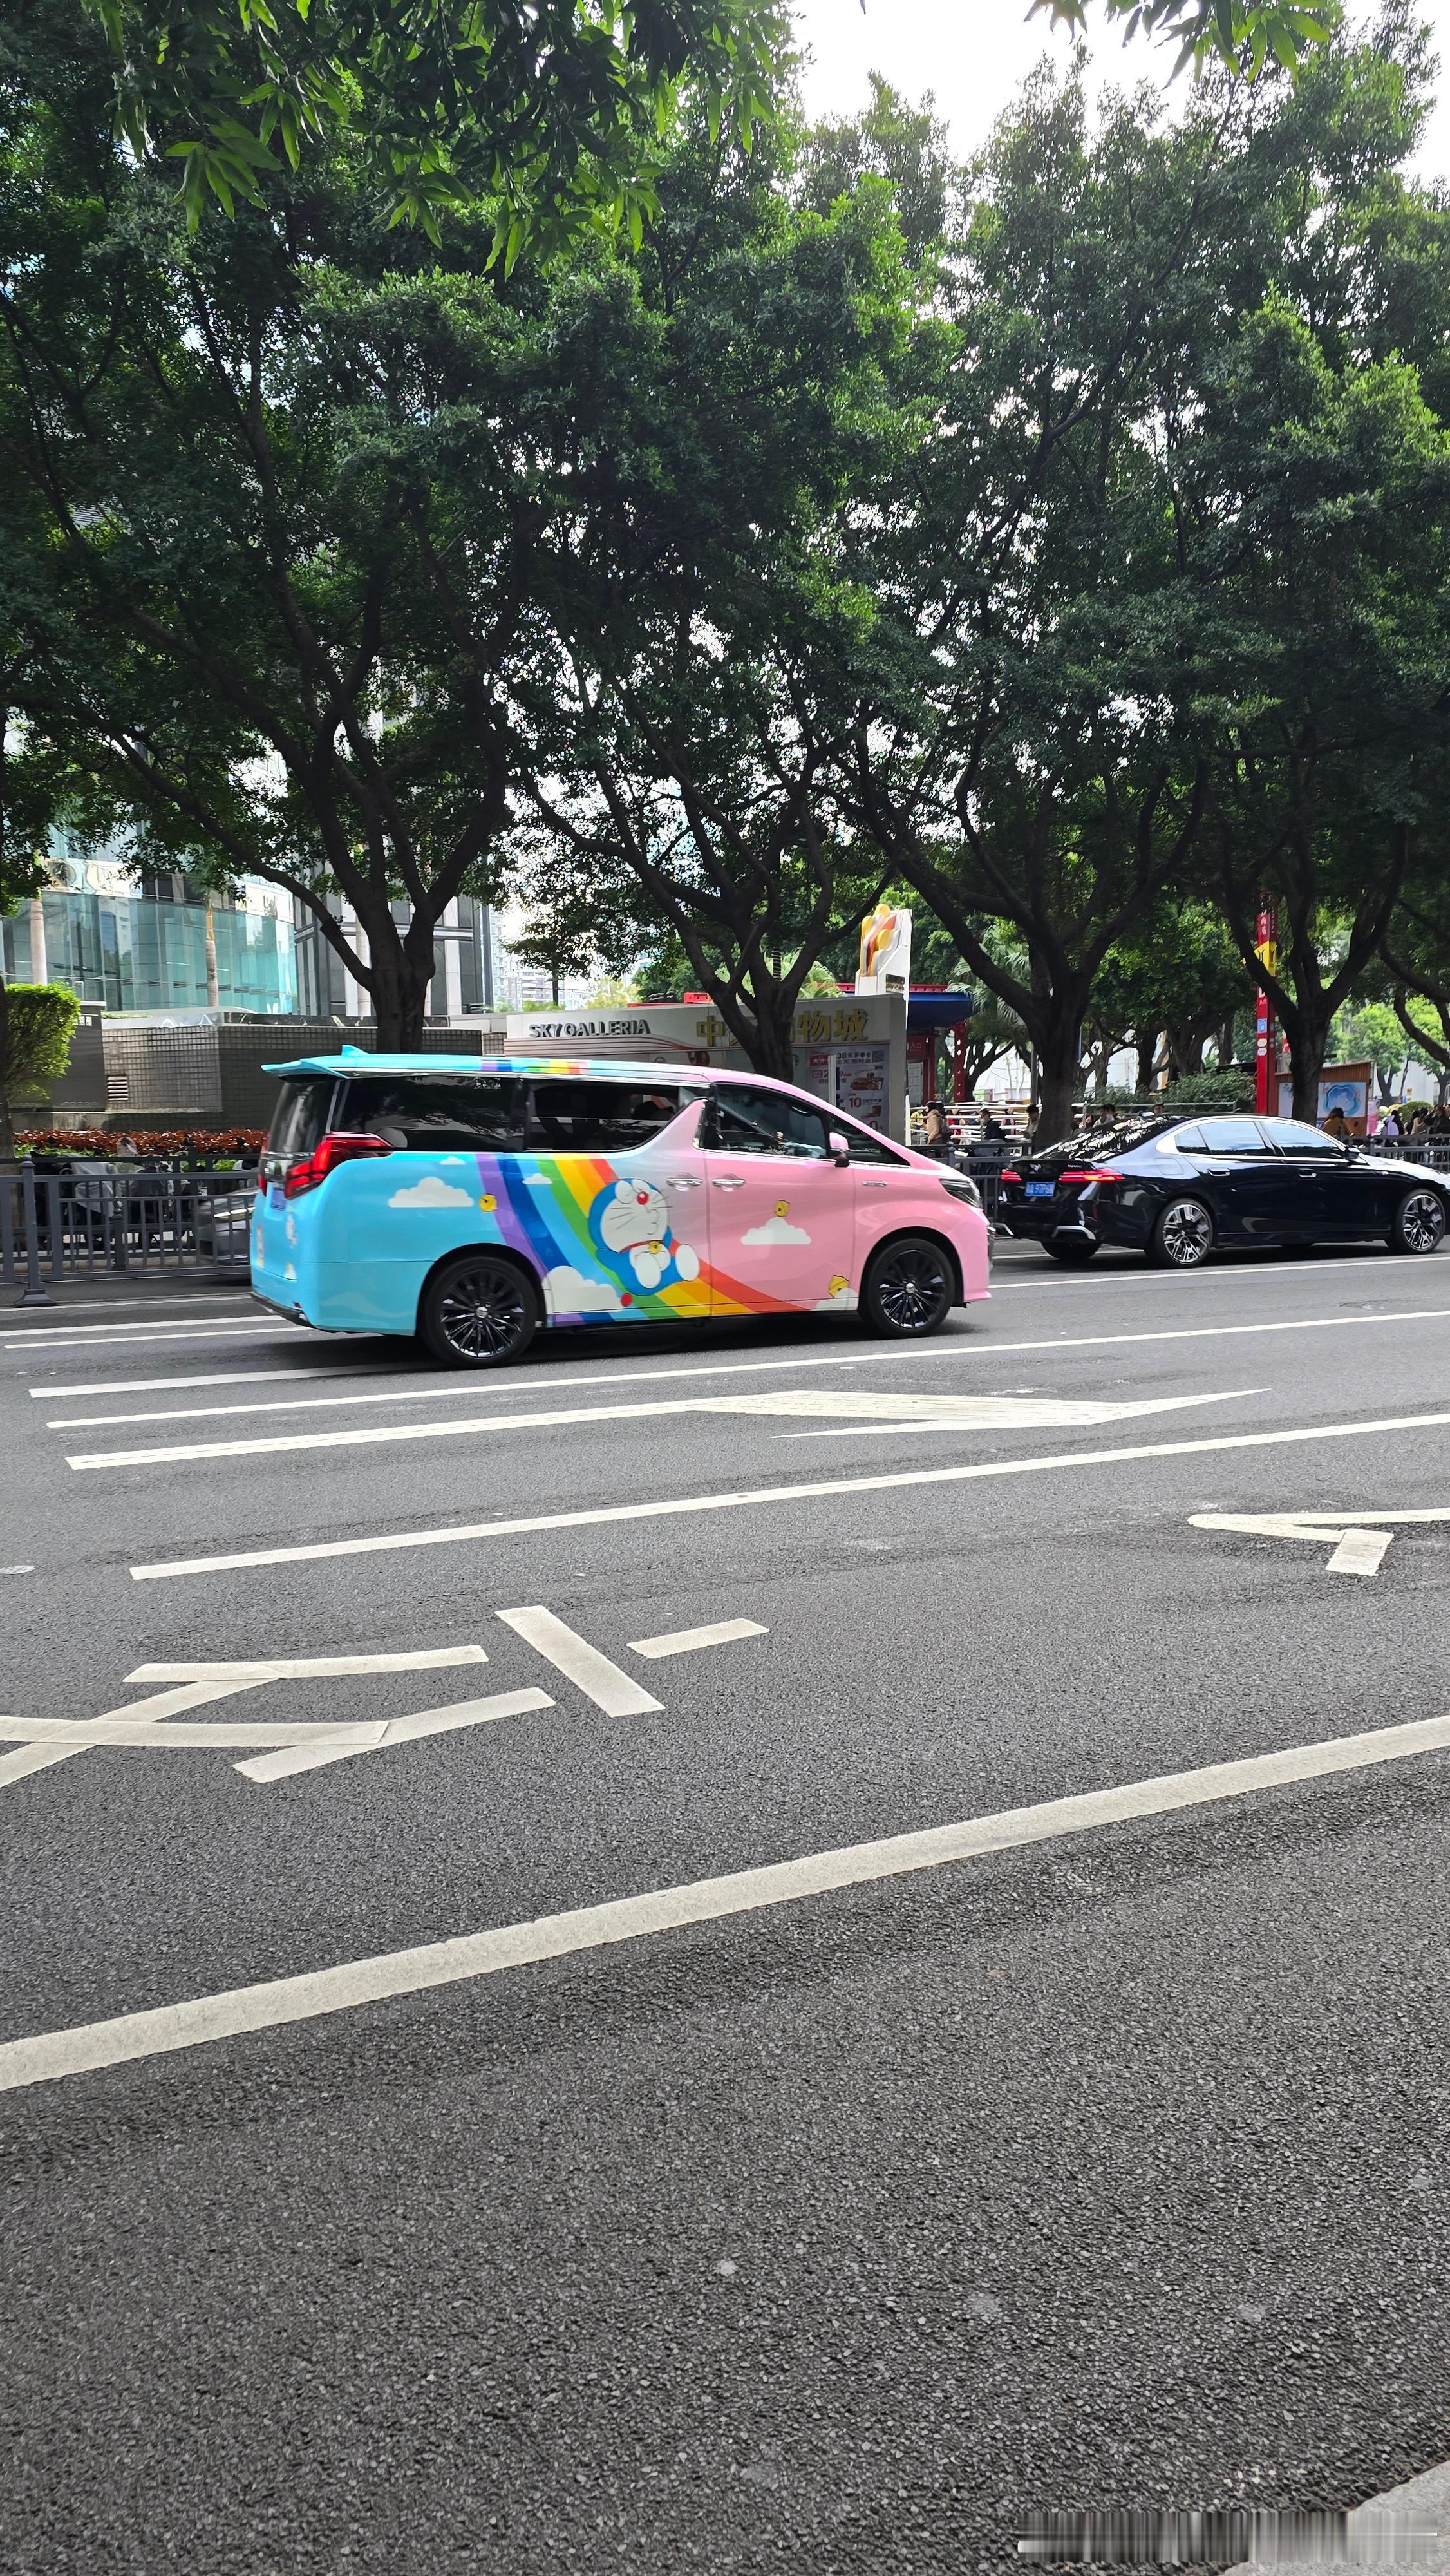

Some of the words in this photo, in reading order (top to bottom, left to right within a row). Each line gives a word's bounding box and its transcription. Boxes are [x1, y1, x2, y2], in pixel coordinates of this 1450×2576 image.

[529, 1023, 563, 1037] SKY
[563, 1019, 652, 1037] GALLERIA
[696, 1008, 869, 1047] 中物城
[849, 1097, 862, 1108] 10
